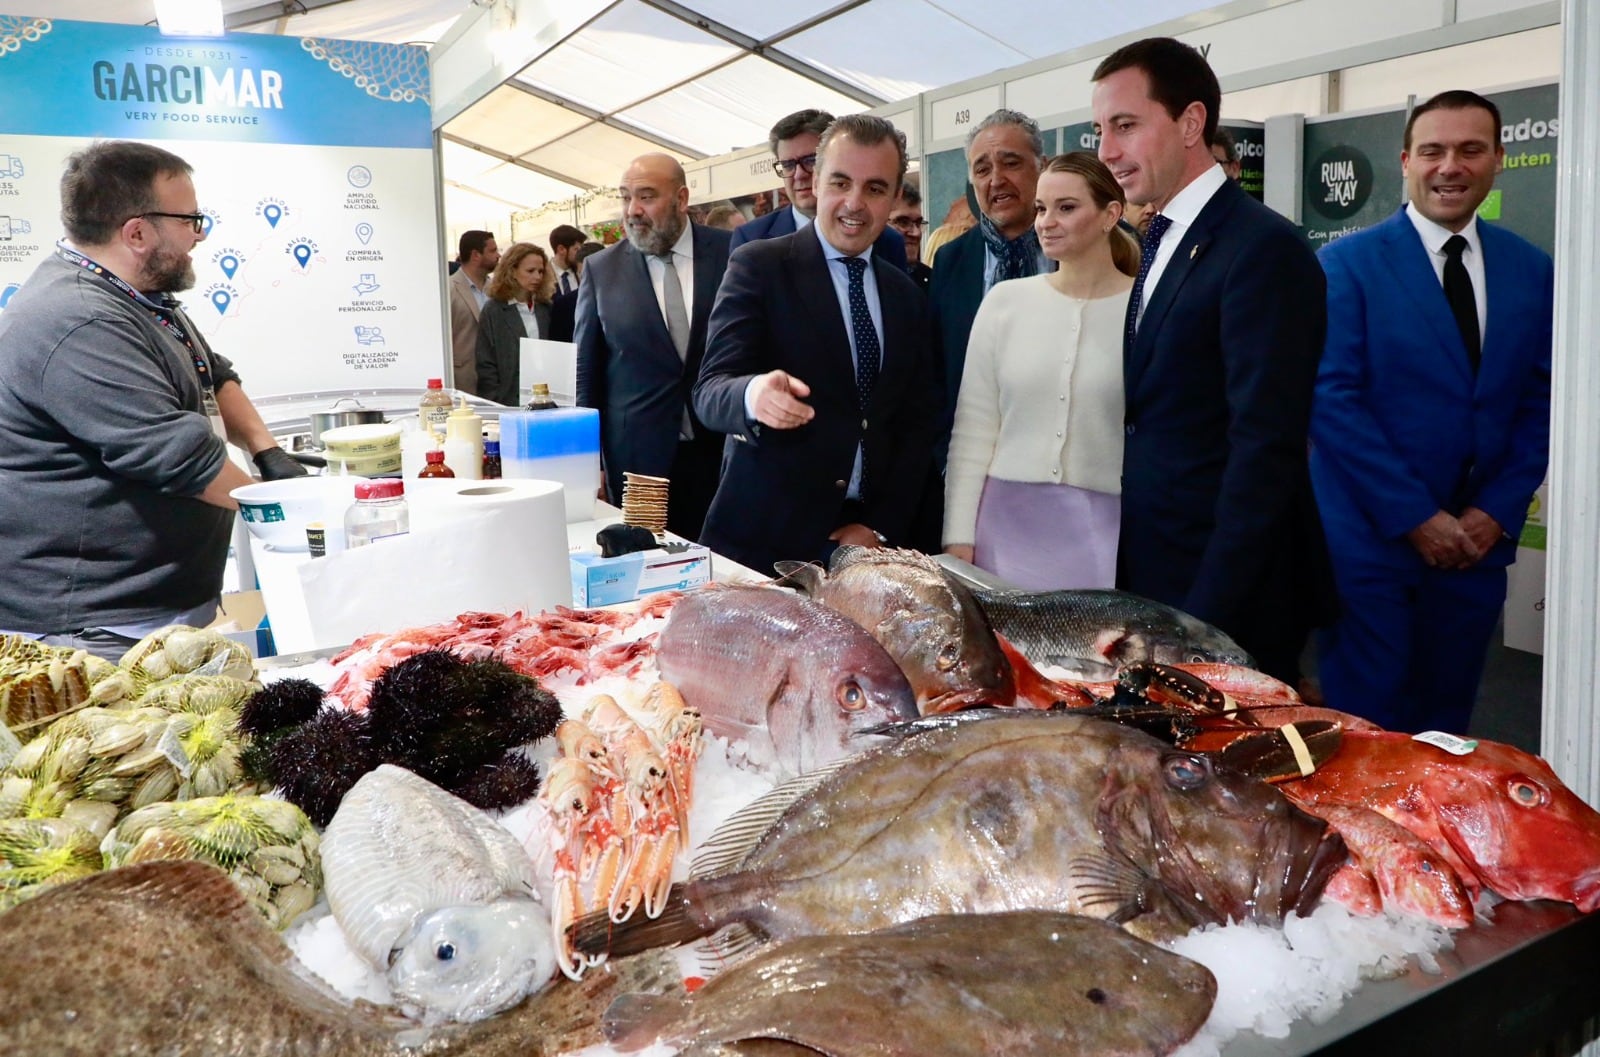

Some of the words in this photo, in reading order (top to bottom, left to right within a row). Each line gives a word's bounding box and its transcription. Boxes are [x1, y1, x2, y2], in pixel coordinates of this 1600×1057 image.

[144, 46, 193, 58] DESDE
[202, 50, 232, 61] 1931
[93, 60, 284, 110] GARCIMAR
[124, 111, 157, 121] VERY
[163, 113, 200, 122] FOOD
[206, 115, 259, 125] SERVICE
[955, 109, 970, 125] A39
[749, 157, 778, 177] YATECO
[1502, 151, 1551, 169] luten
[1321, 160, 1355, 187] RUNA
[1334, 179, 1358, 207] KAY
[1307, 229, 1327, 239] Con
[285, 236, 319, 254] MALLORCA
[211, 248, 247, 264] VALENCIA
[203, 283, 239, 298] ALICANTE
[338, 305, 398, 313] PERSONALIZADO
